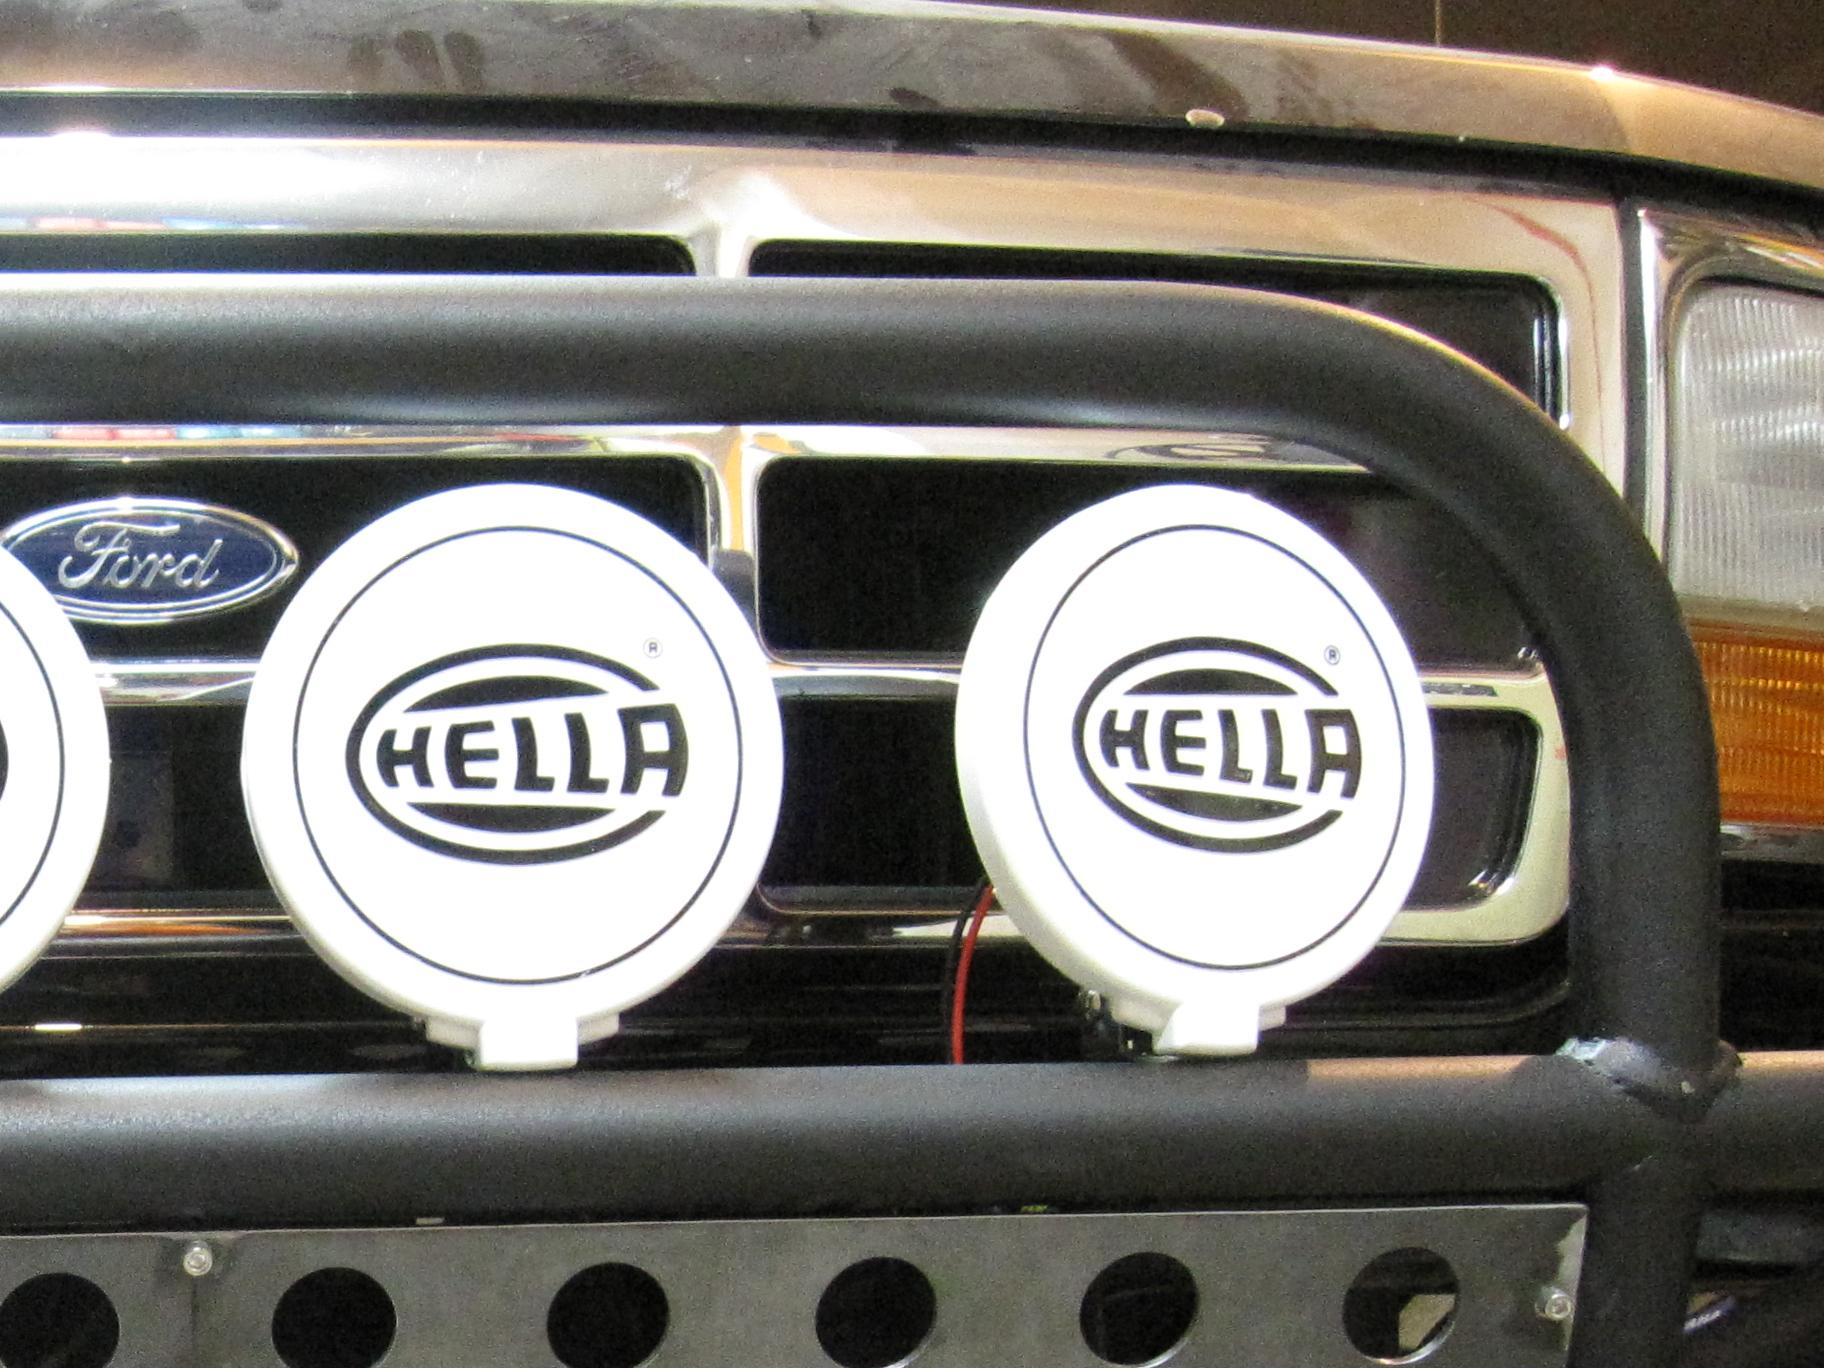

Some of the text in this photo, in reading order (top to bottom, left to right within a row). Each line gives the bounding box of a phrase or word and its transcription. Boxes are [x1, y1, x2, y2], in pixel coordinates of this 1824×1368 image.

[58, 520, 223, 589] Ford
[376, 703, 689, 797] HELLA
[1099, 708, 1362, 799] HELLA
